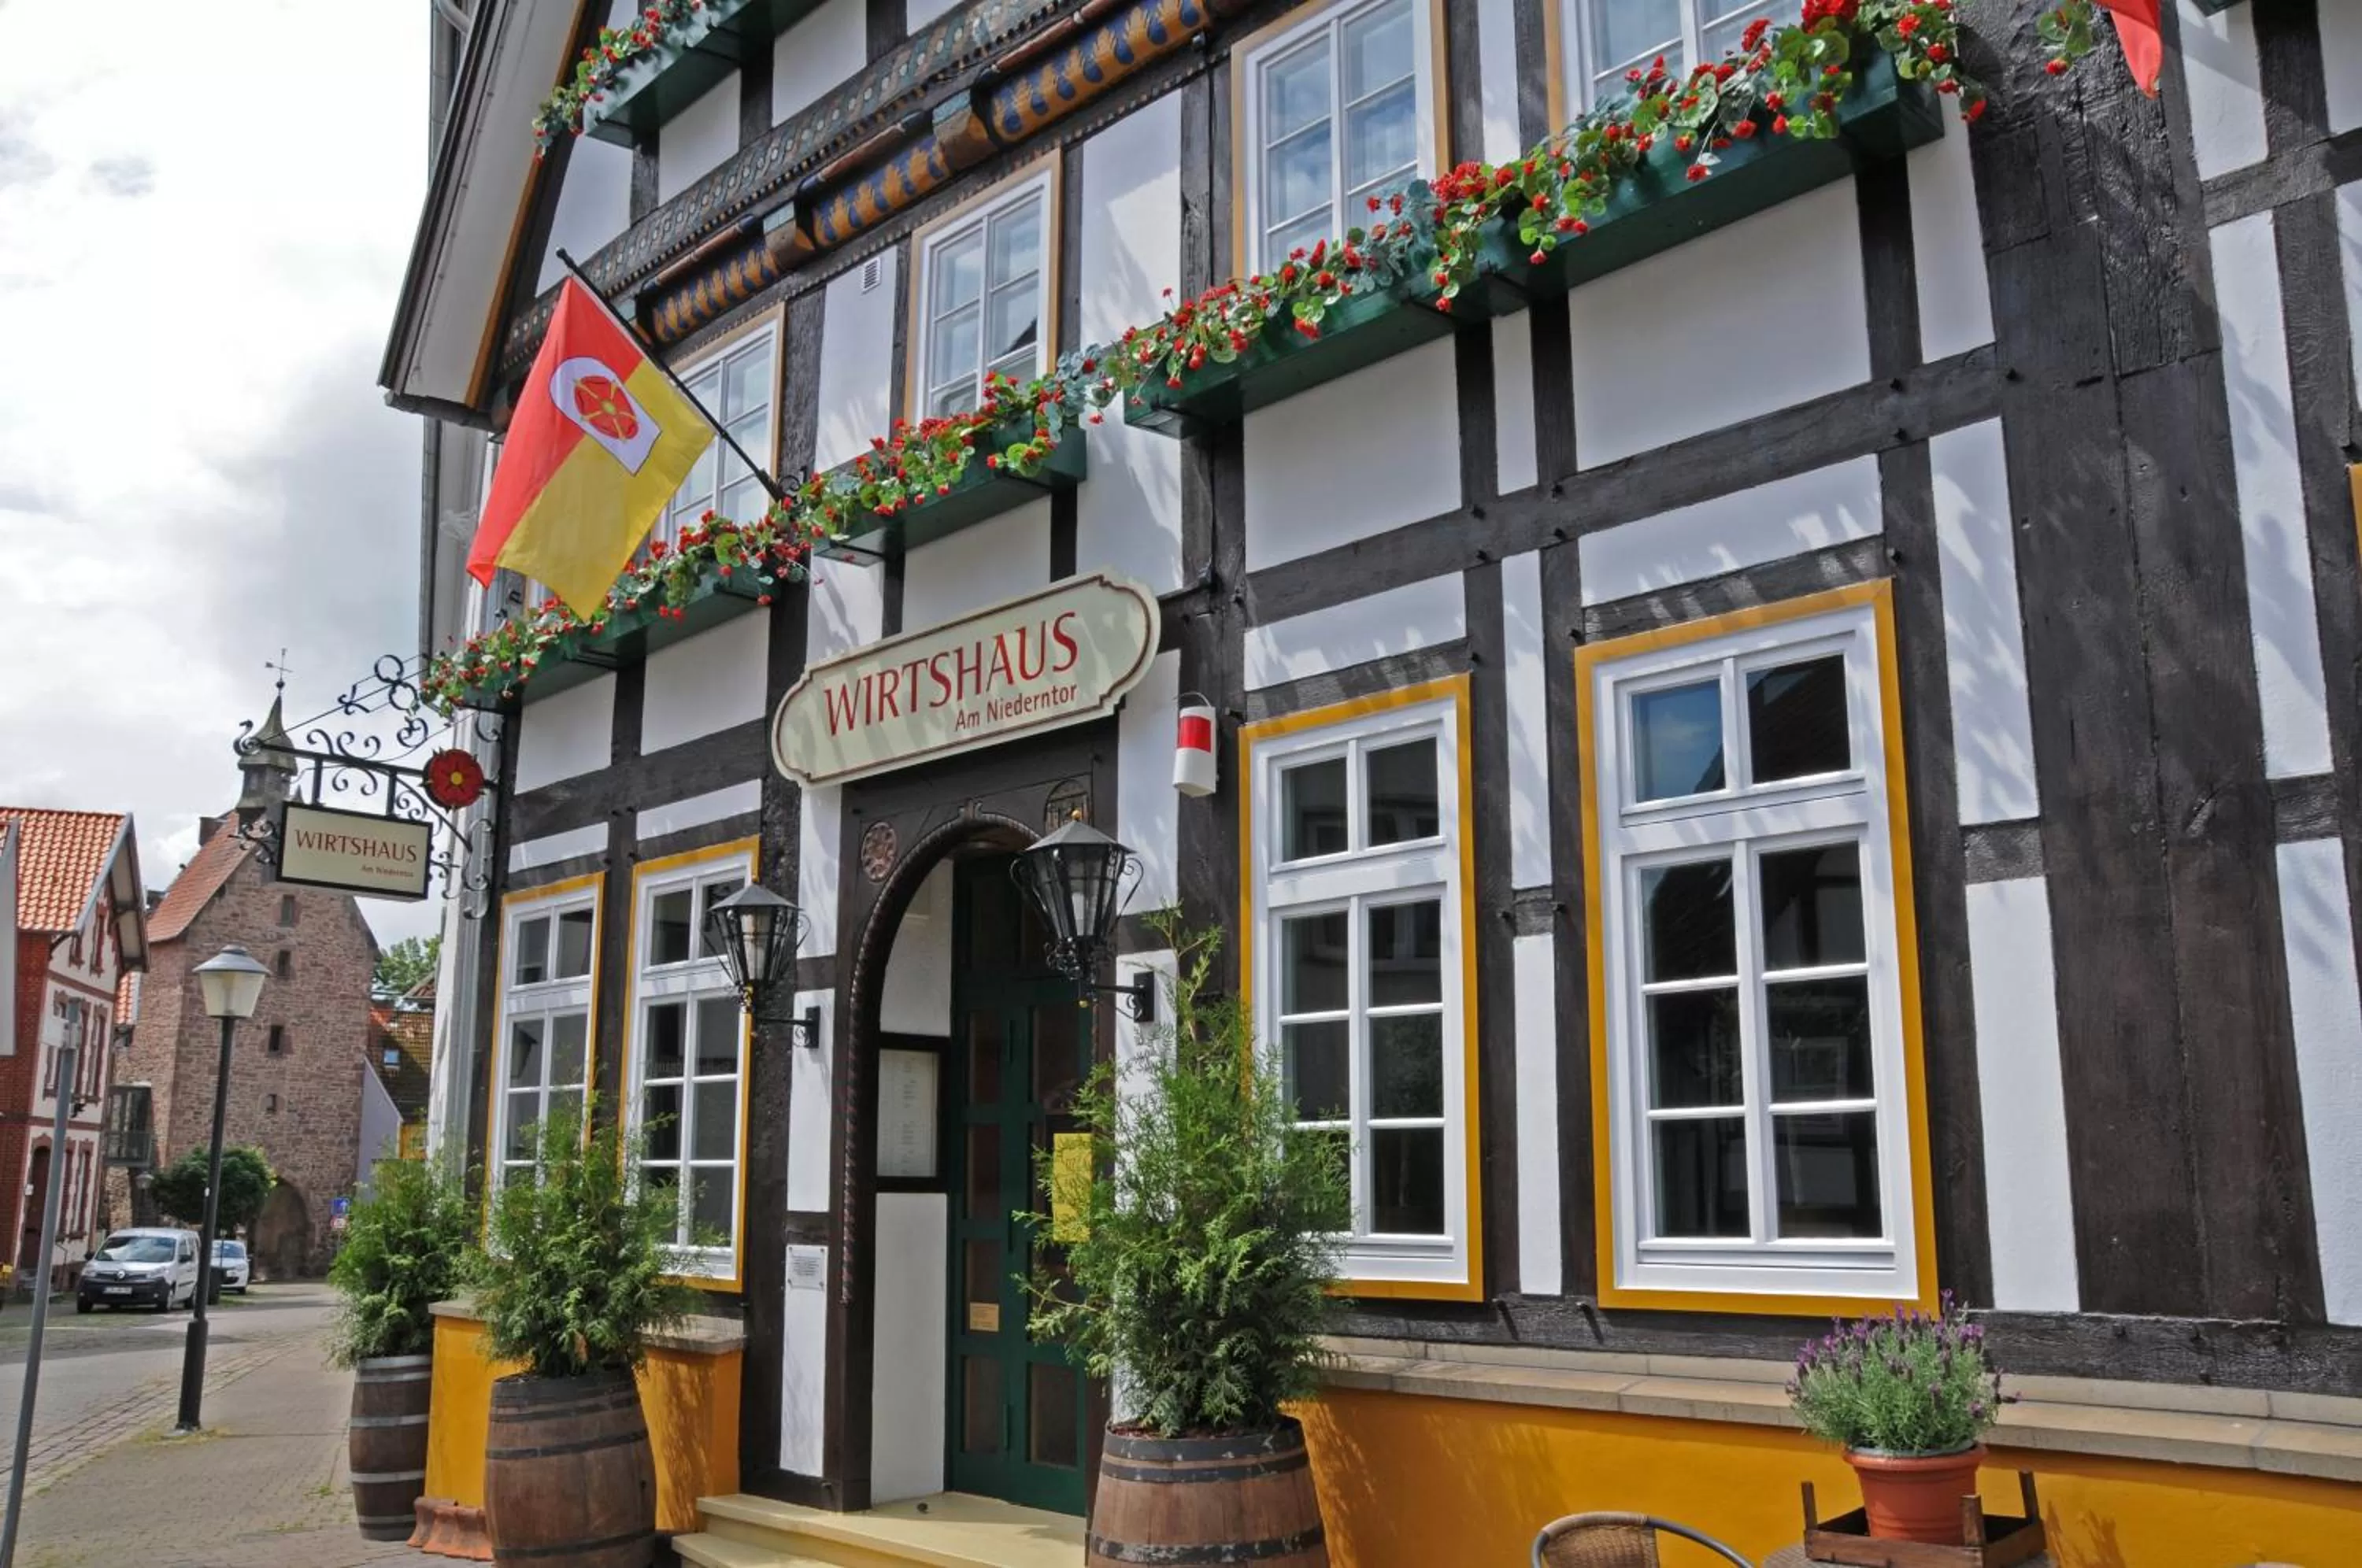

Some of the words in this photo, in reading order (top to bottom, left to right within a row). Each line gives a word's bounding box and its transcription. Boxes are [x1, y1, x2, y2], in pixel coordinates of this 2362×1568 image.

[824, 612, 1078, 736] WIRTSHAUS
[955, 709, 980, 732] Am
[987, 683, 1077, 723] Niederntor
[295, 830, 417, 863] WIRTSHAUS
